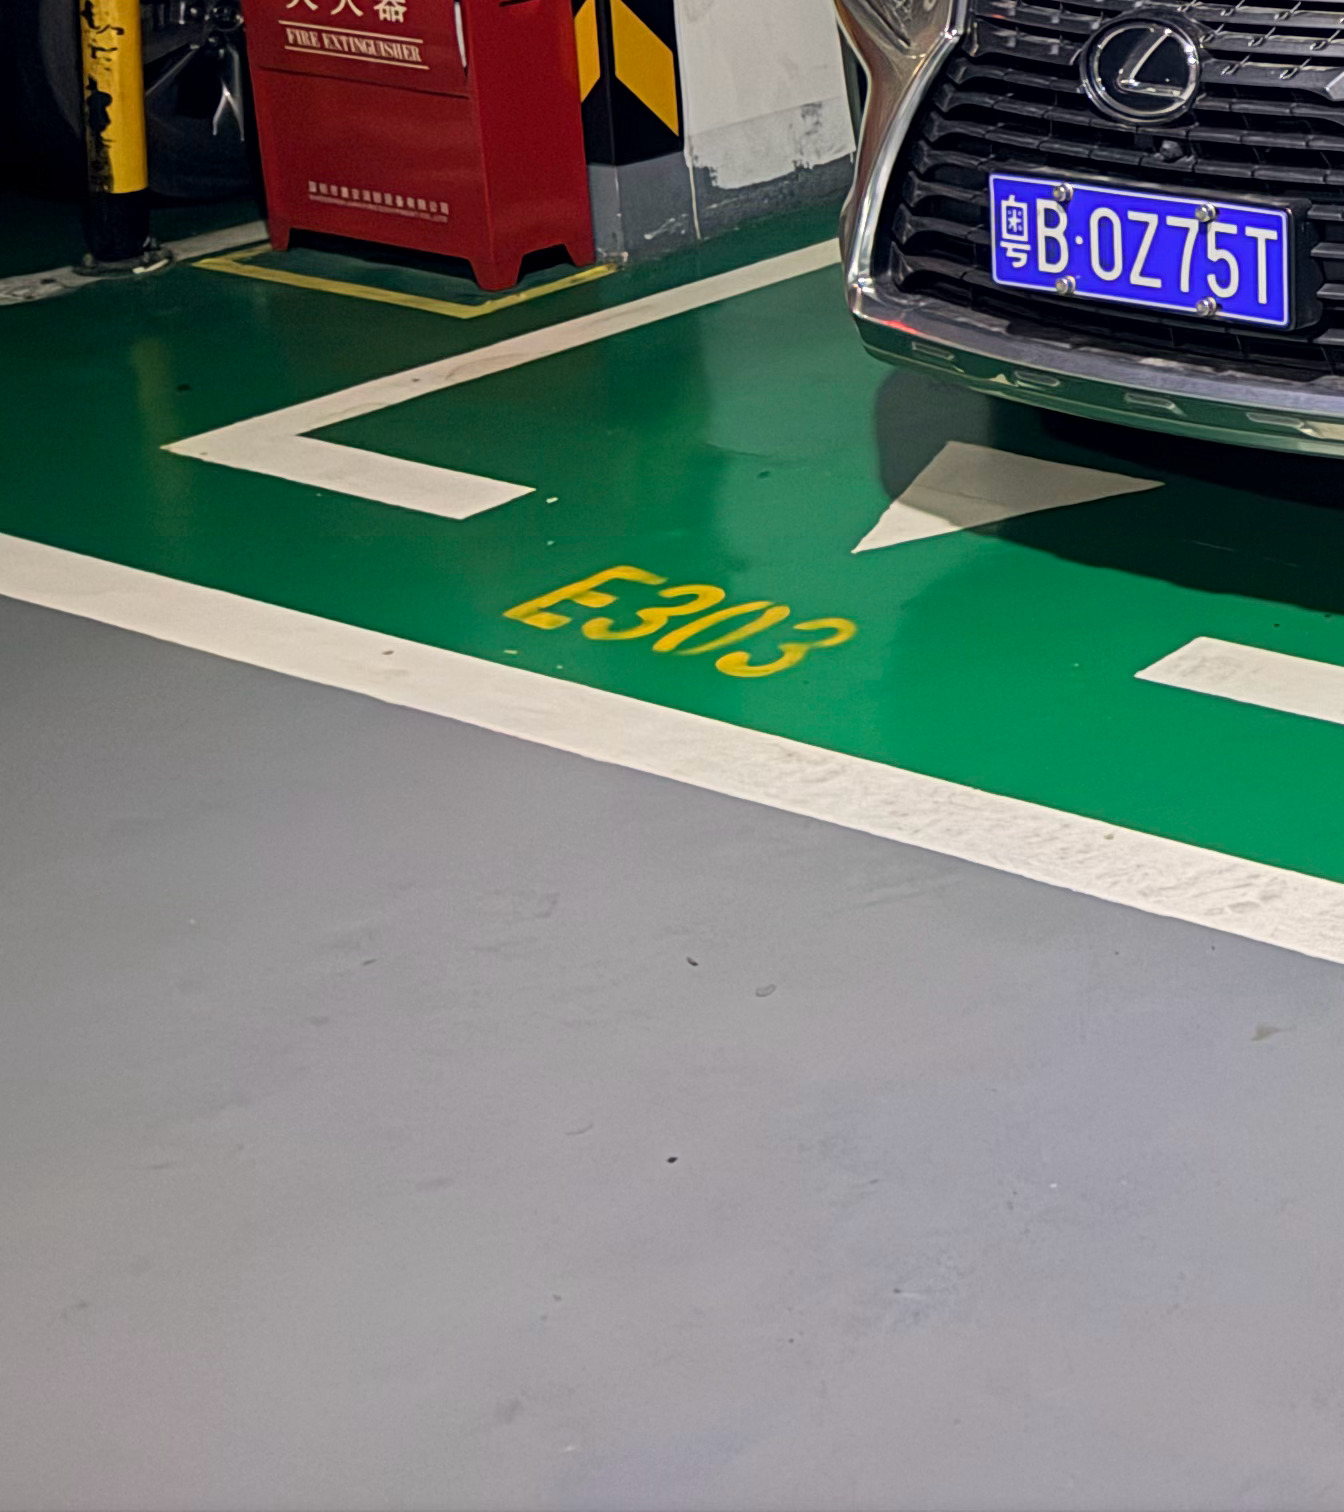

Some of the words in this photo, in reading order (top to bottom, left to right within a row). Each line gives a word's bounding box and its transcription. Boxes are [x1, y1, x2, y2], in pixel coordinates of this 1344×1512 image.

[285, 27, 321, 48] FIRE
[321, 32, 423, 63] EXTINGUISHER
[502, 565, 858, 678] E303
